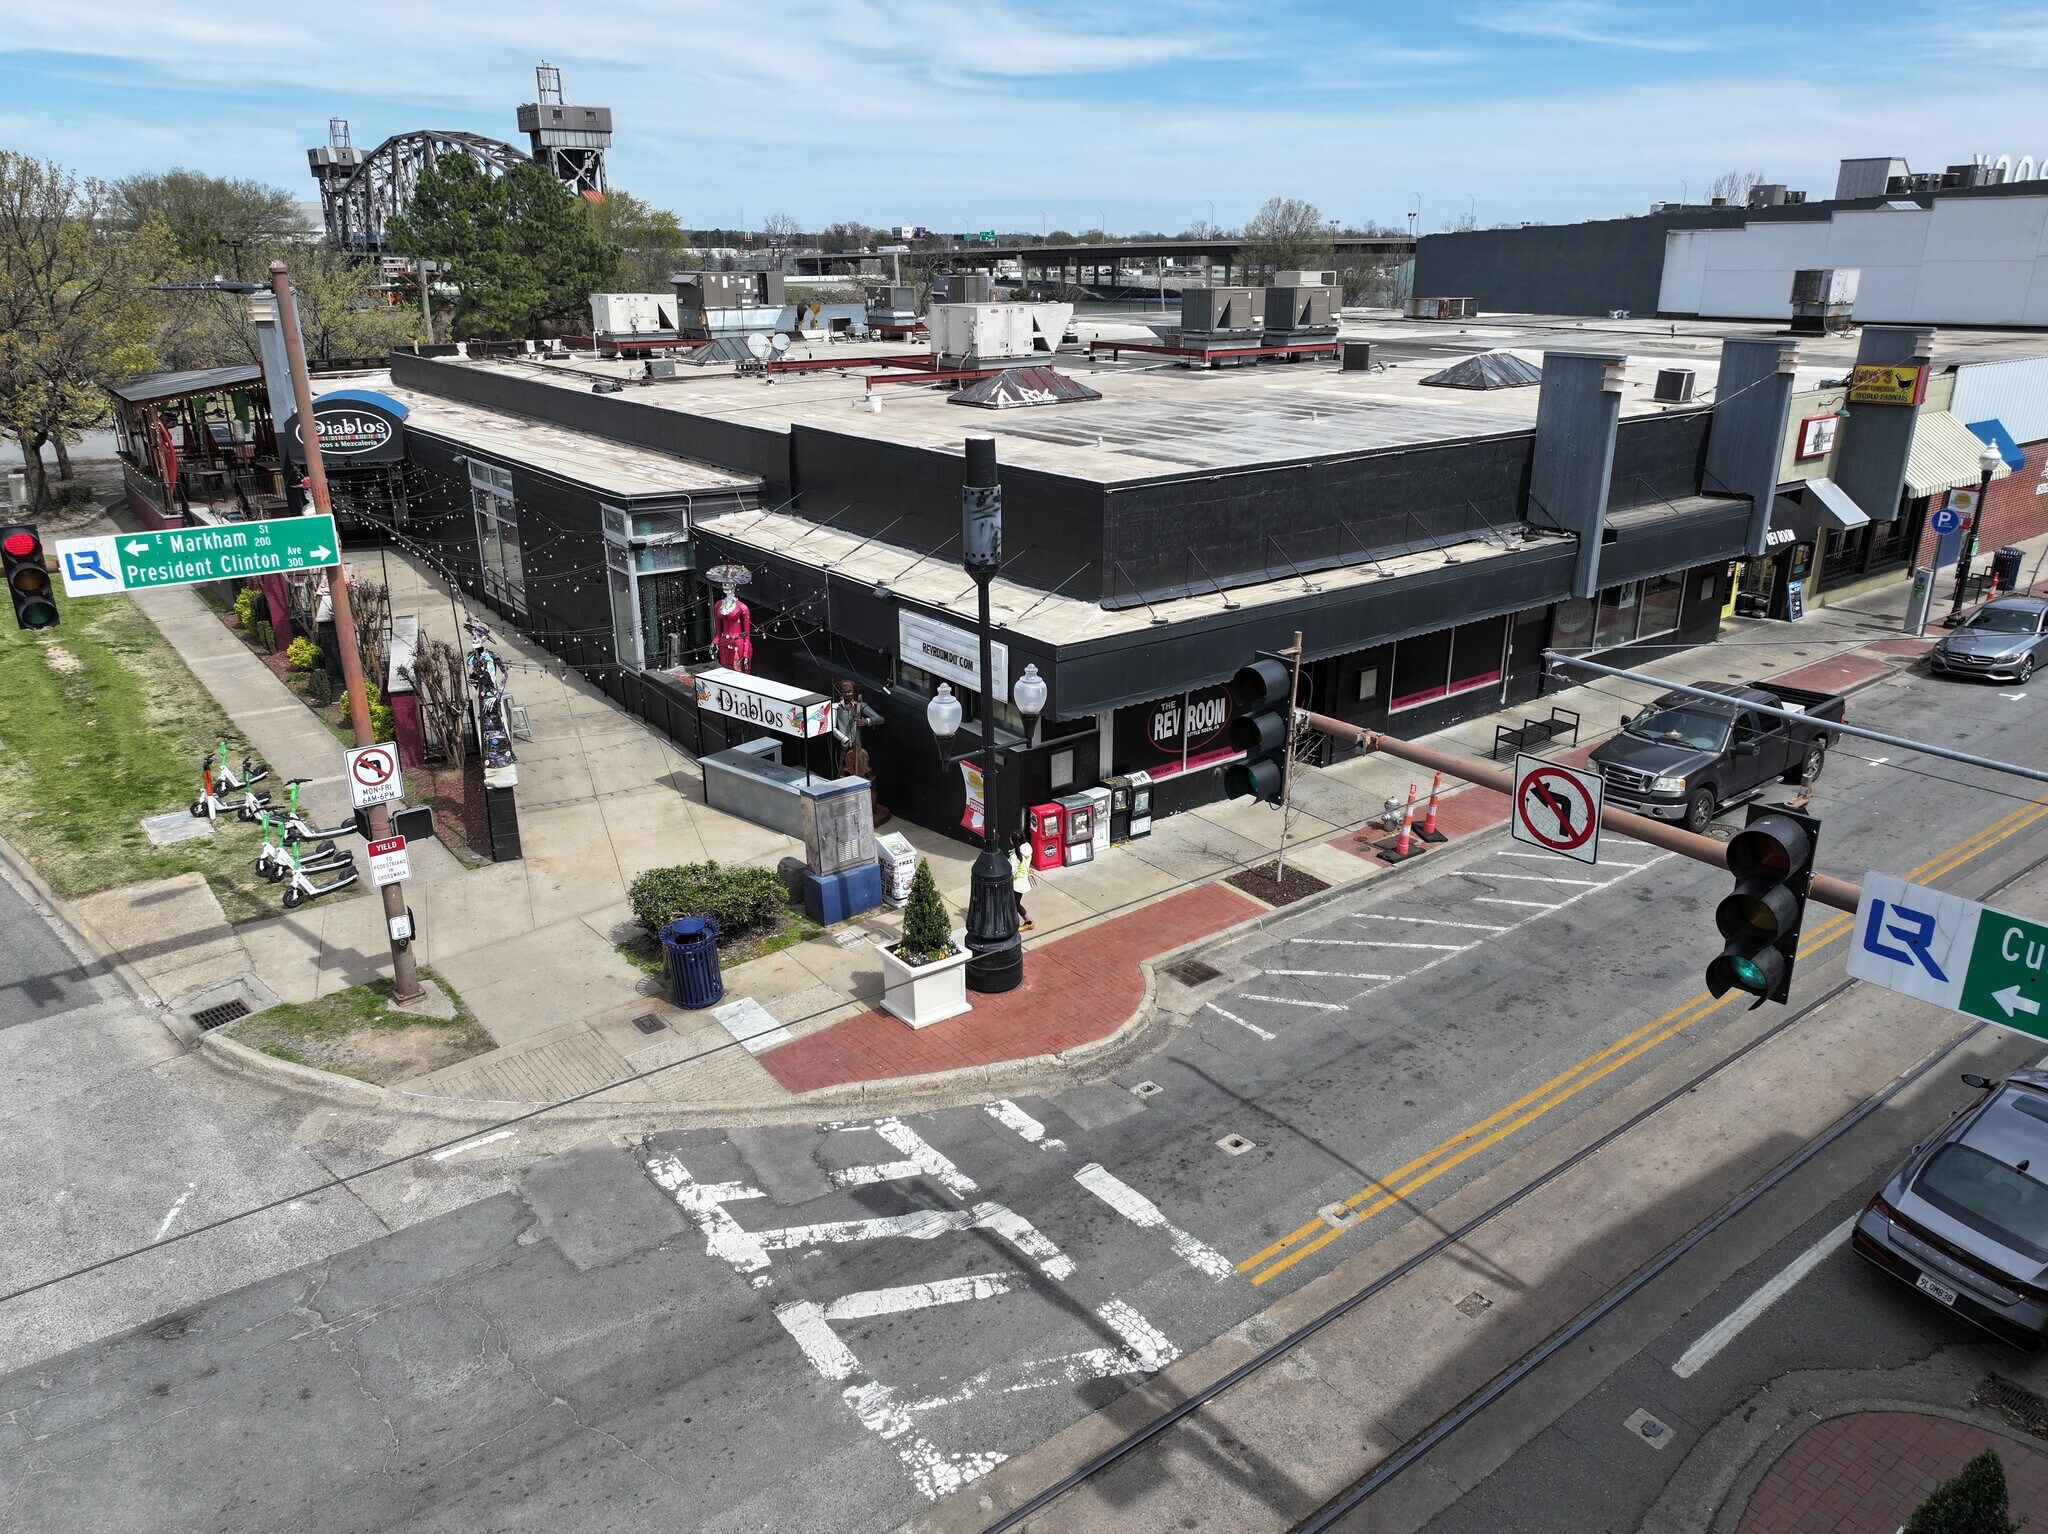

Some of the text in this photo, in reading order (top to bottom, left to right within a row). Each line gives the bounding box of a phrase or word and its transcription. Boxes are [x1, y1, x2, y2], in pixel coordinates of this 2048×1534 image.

[1938, 511, 1952, 527] P
[156, 524, 269, 554] E Markham St
[254, 536, 272, 547] 200
[127, 546, 302, 584] President Clinton Ave
[287, 556, 304, 567] 300
[959, 656, 974, 671] COM
[715, 687, 784, 728] Diablos
[1161, 701, 1176, 711] THE
[1154, 698, 1226, 741] REV ROOM
[362, 785, 392, 796] MON-FRI
[362, 791, 395, 804] 6AM-6PM
[375, 841, 397, 852] YIELD
[373, 859, 406, 870] PEDESTRIANS
[378, 870, 406, 881] CROSSWALK
[2001, 927, 2048, 974] Cu
